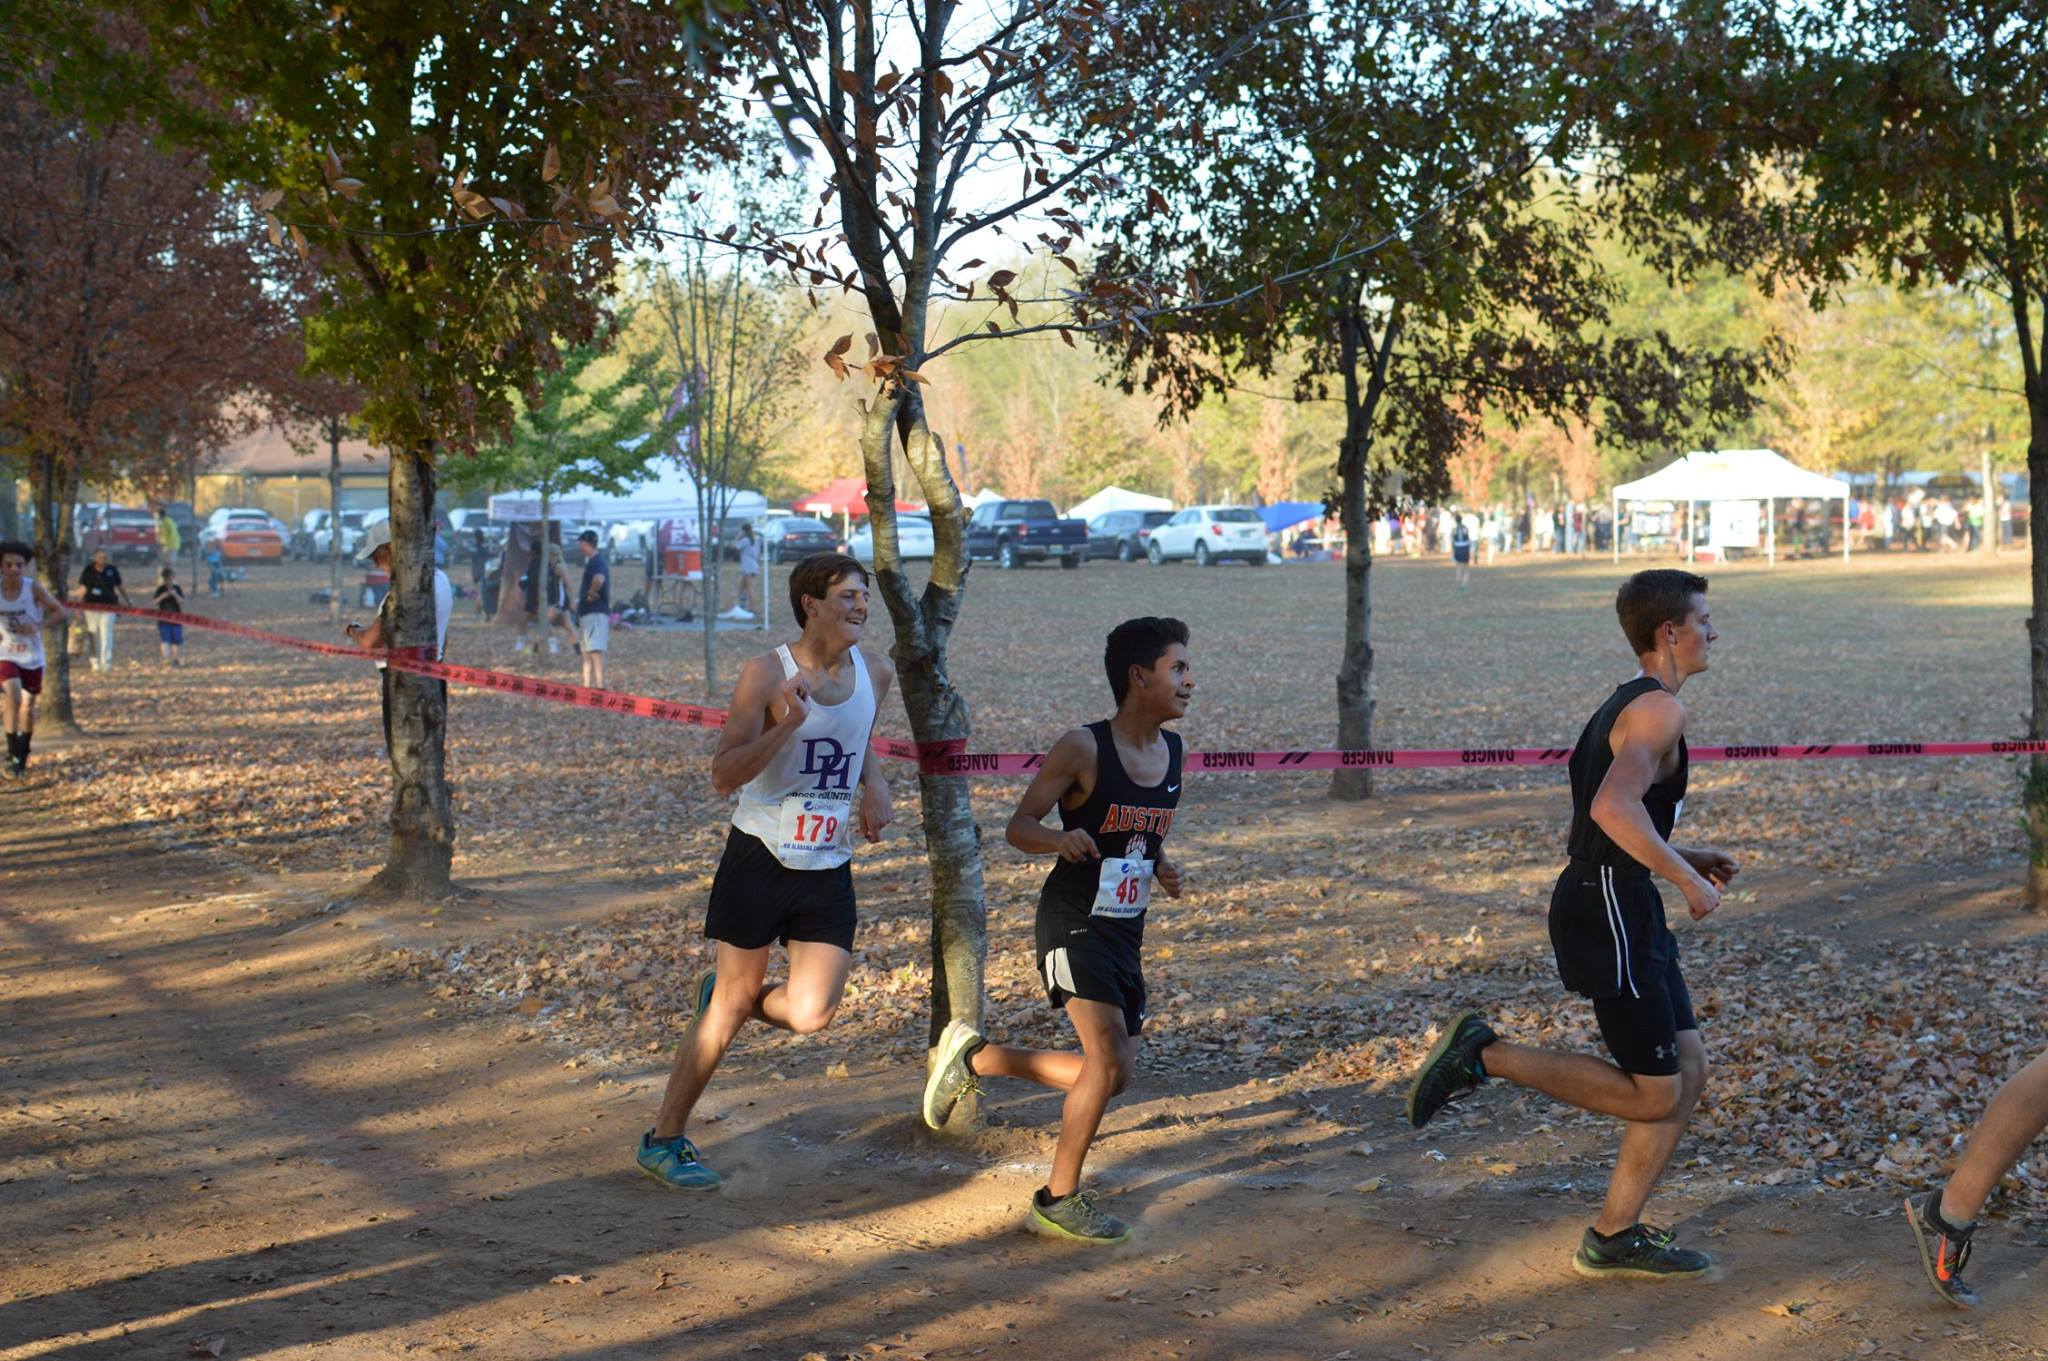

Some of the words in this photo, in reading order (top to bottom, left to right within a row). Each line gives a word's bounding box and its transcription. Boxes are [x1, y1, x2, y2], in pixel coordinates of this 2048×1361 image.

[947, 753, 999, 771] DANGER
[1202, 752, 1255, 768] DANGER
[1342, 750, 1394, 765] DANGER
[1461, 748, 1515, 763] DANGER
[794, 815, 838, 842] 179
[1116, 877, 1139, 904] 46
